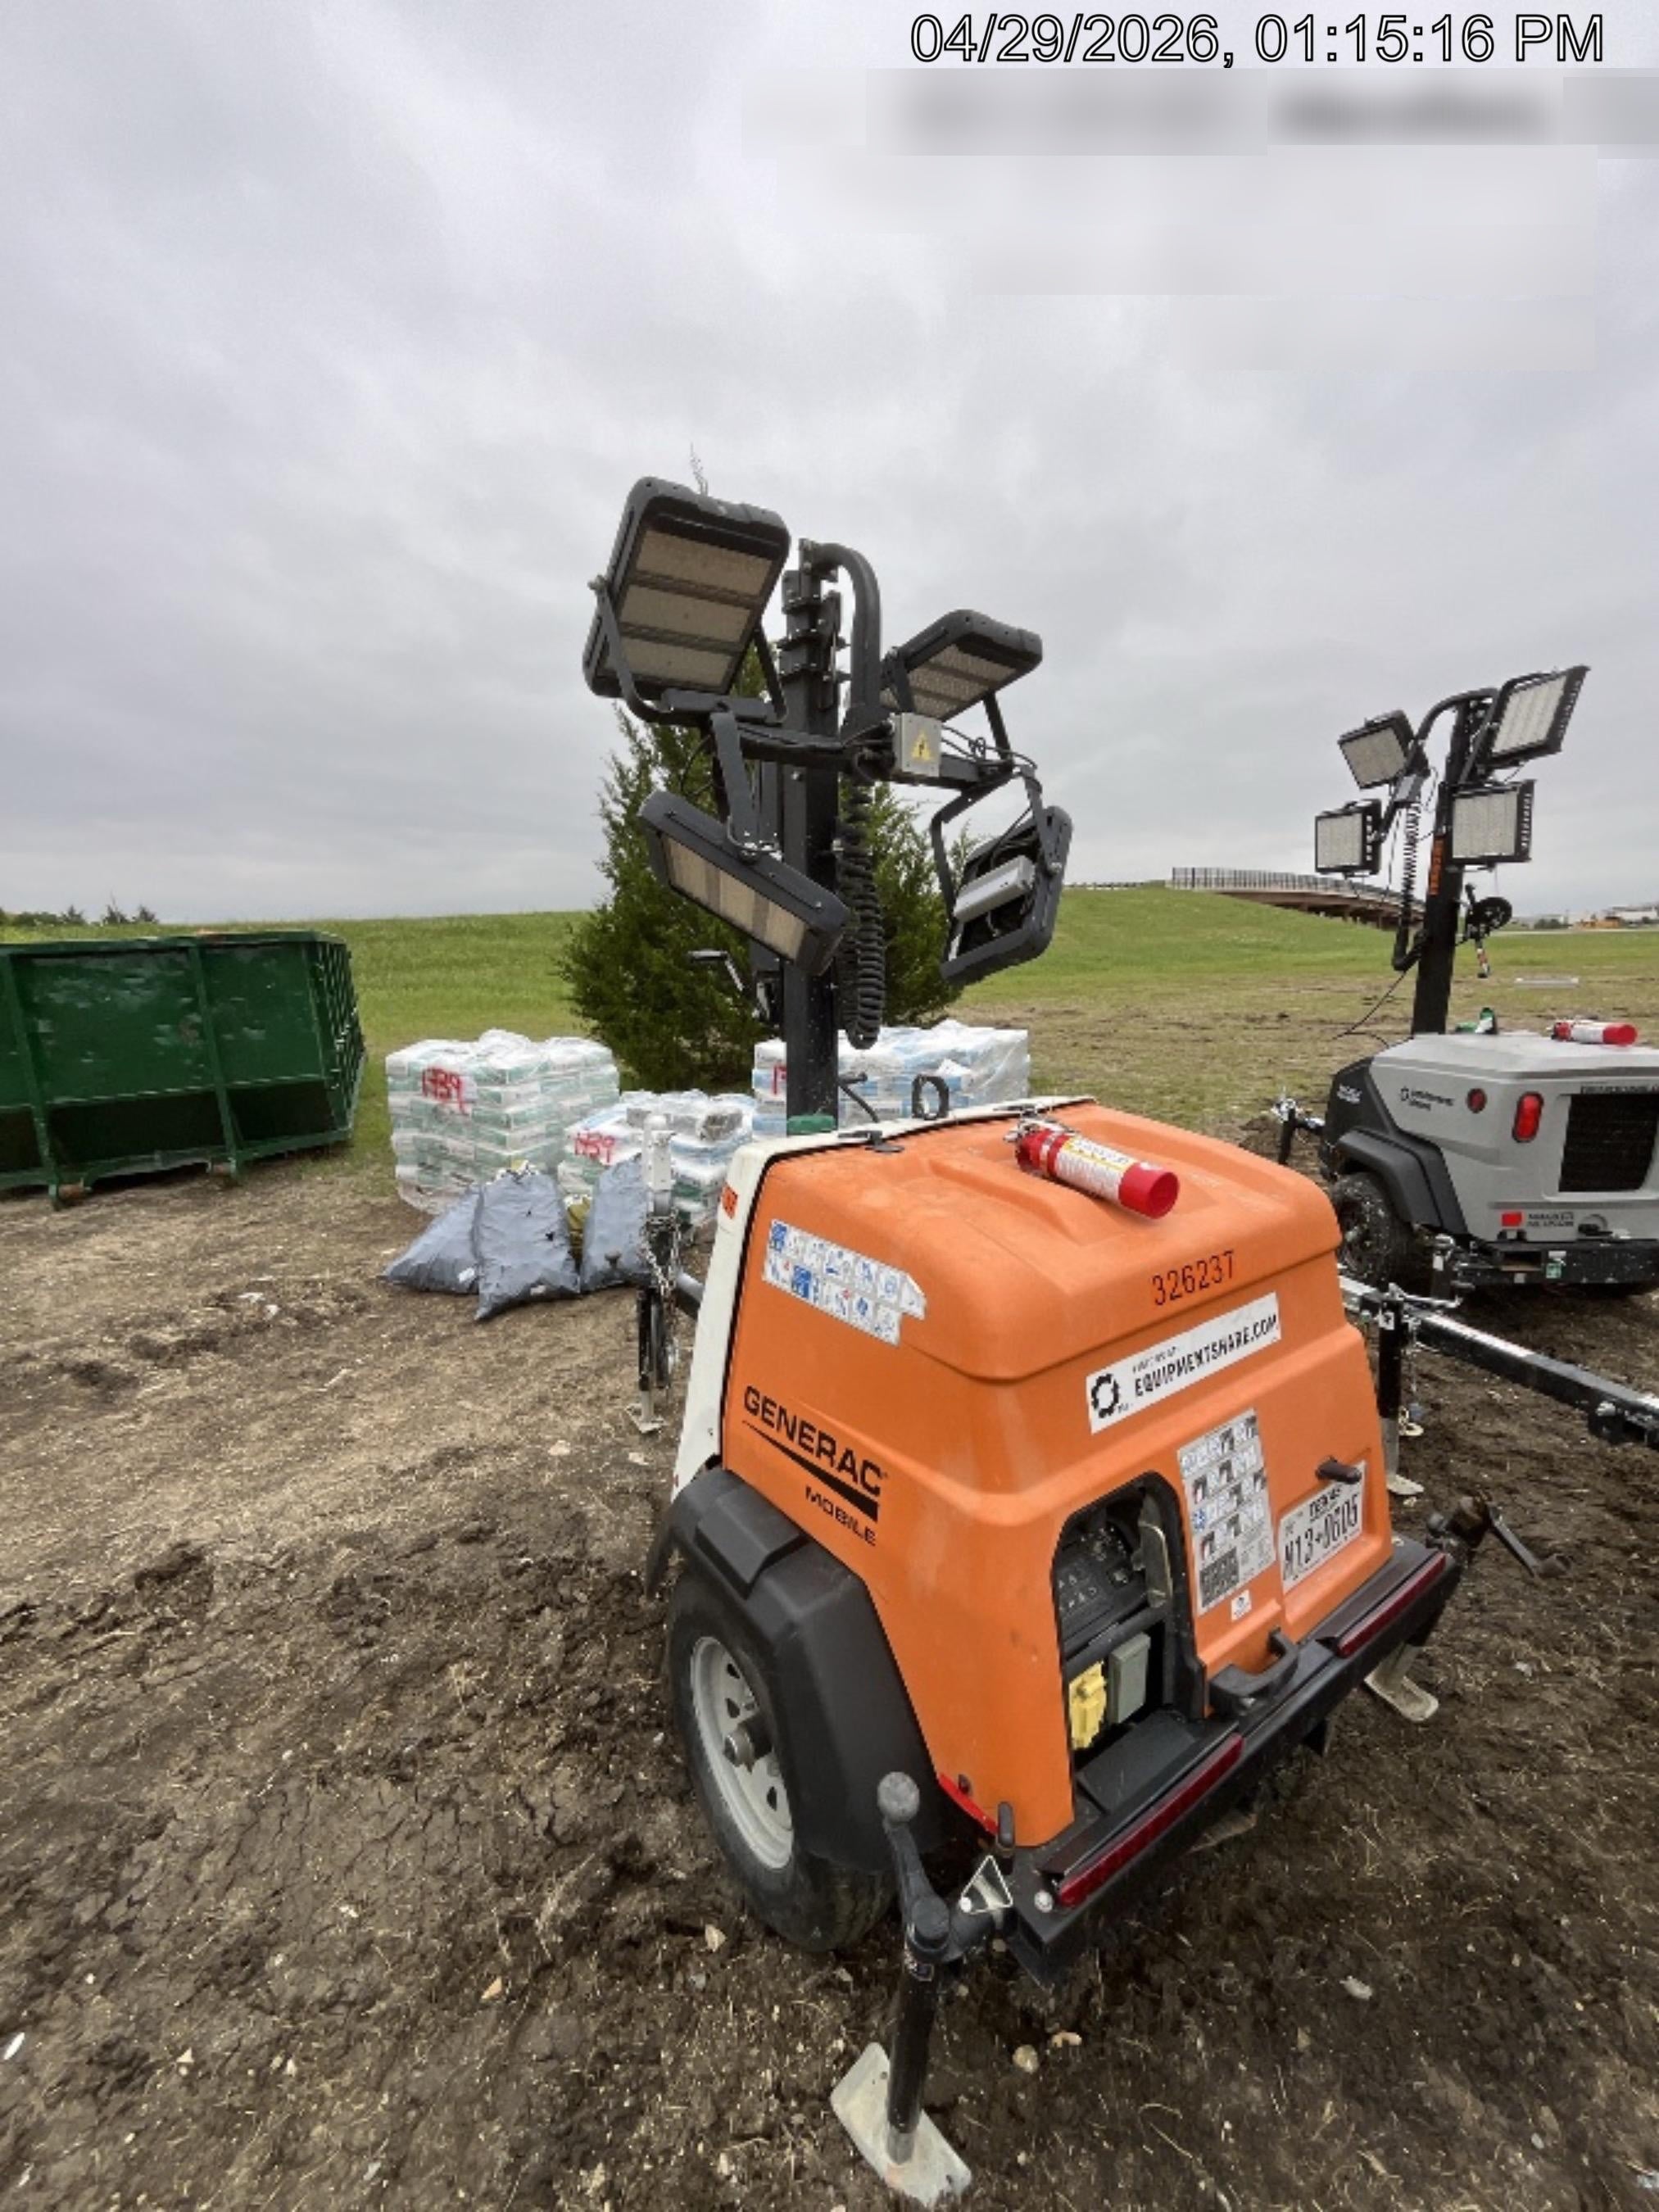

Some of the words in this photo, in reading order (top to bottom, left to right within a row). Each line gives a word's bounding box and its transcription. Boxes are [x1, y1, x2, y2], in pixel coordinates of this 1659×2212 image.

[1152, 1250, 1234, 1307] 326237
[1135, 1314, 1276, 1397] EQUIPMENTSHARE.COM
[744, 1385, 882, 1498] GENERAC
[805, 1485, 877, 1547] MOBILE
